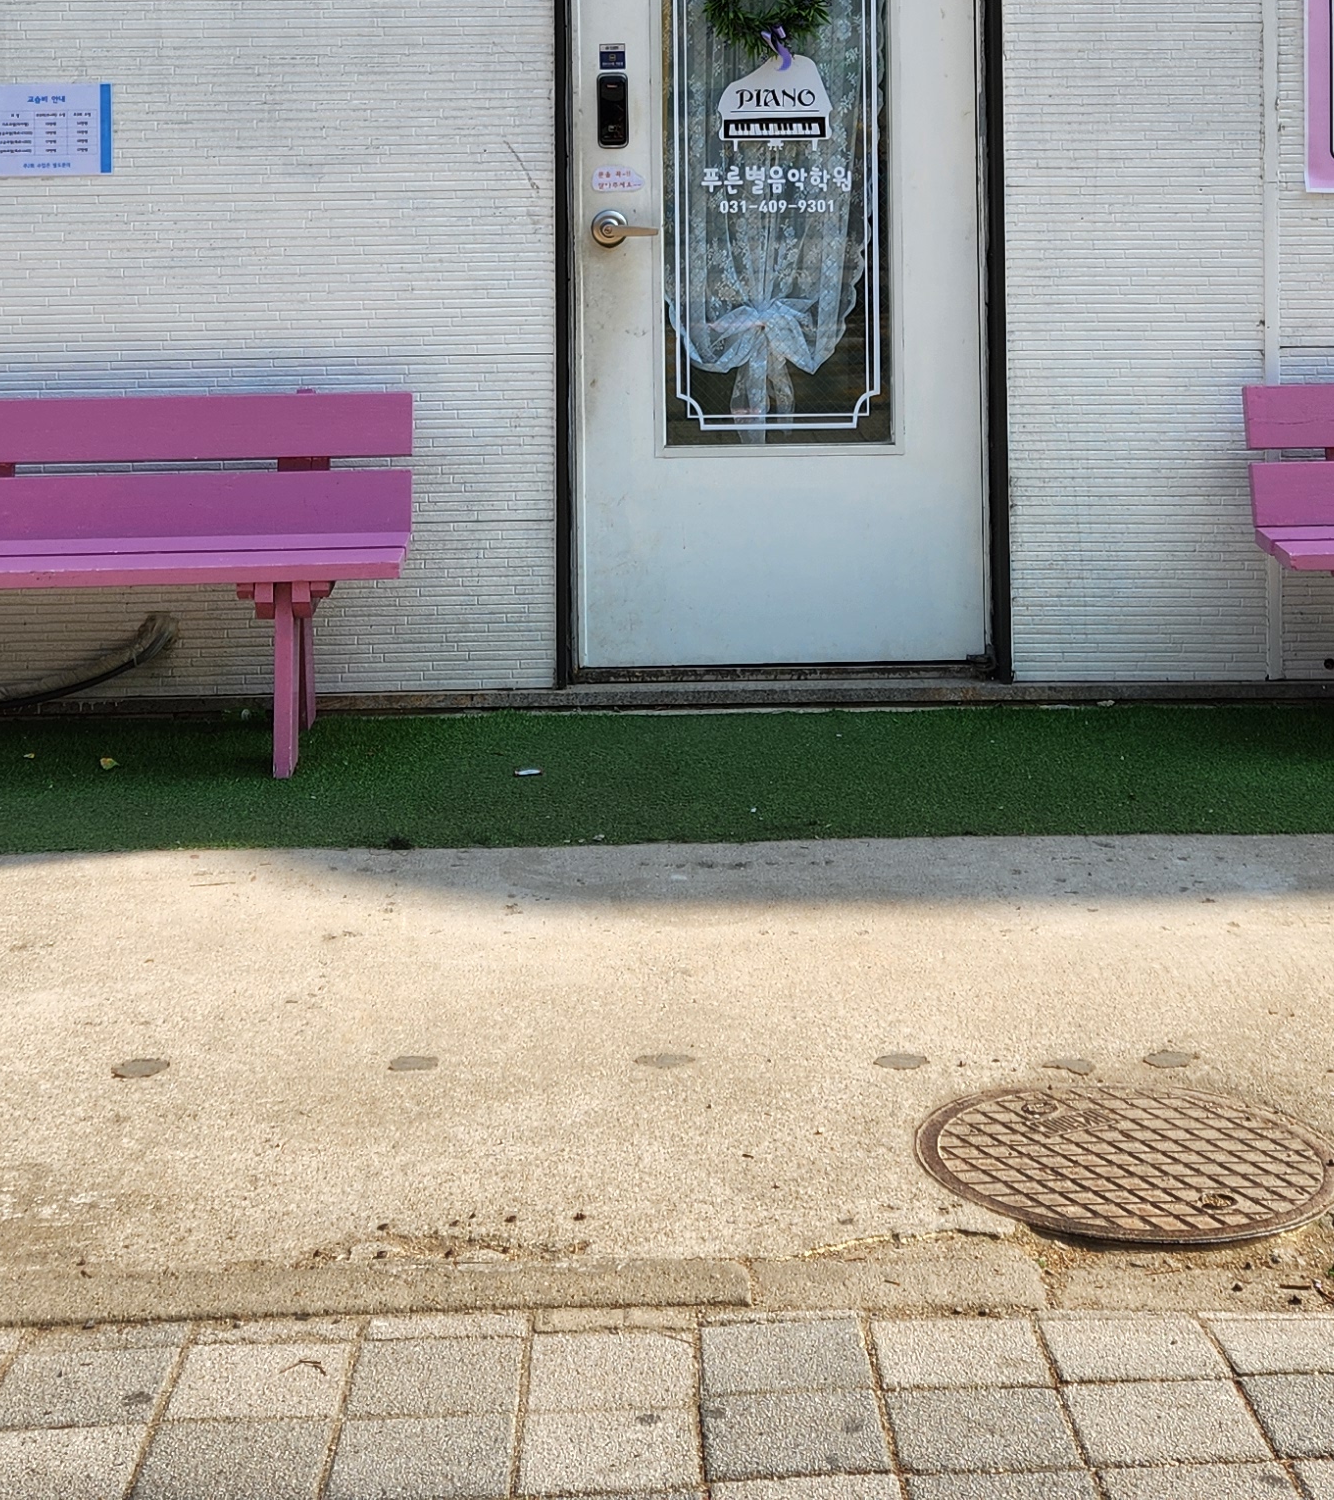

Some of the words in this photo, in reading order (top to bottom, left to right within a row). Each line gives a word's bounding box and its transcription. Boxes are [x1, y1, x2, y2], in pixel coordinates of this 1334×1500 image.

[736, 88, 815, 109] PIANO
[701, 165, 851, 194] 푸른별음악학원
[720, 200, 834, 213] 031-409-9301
